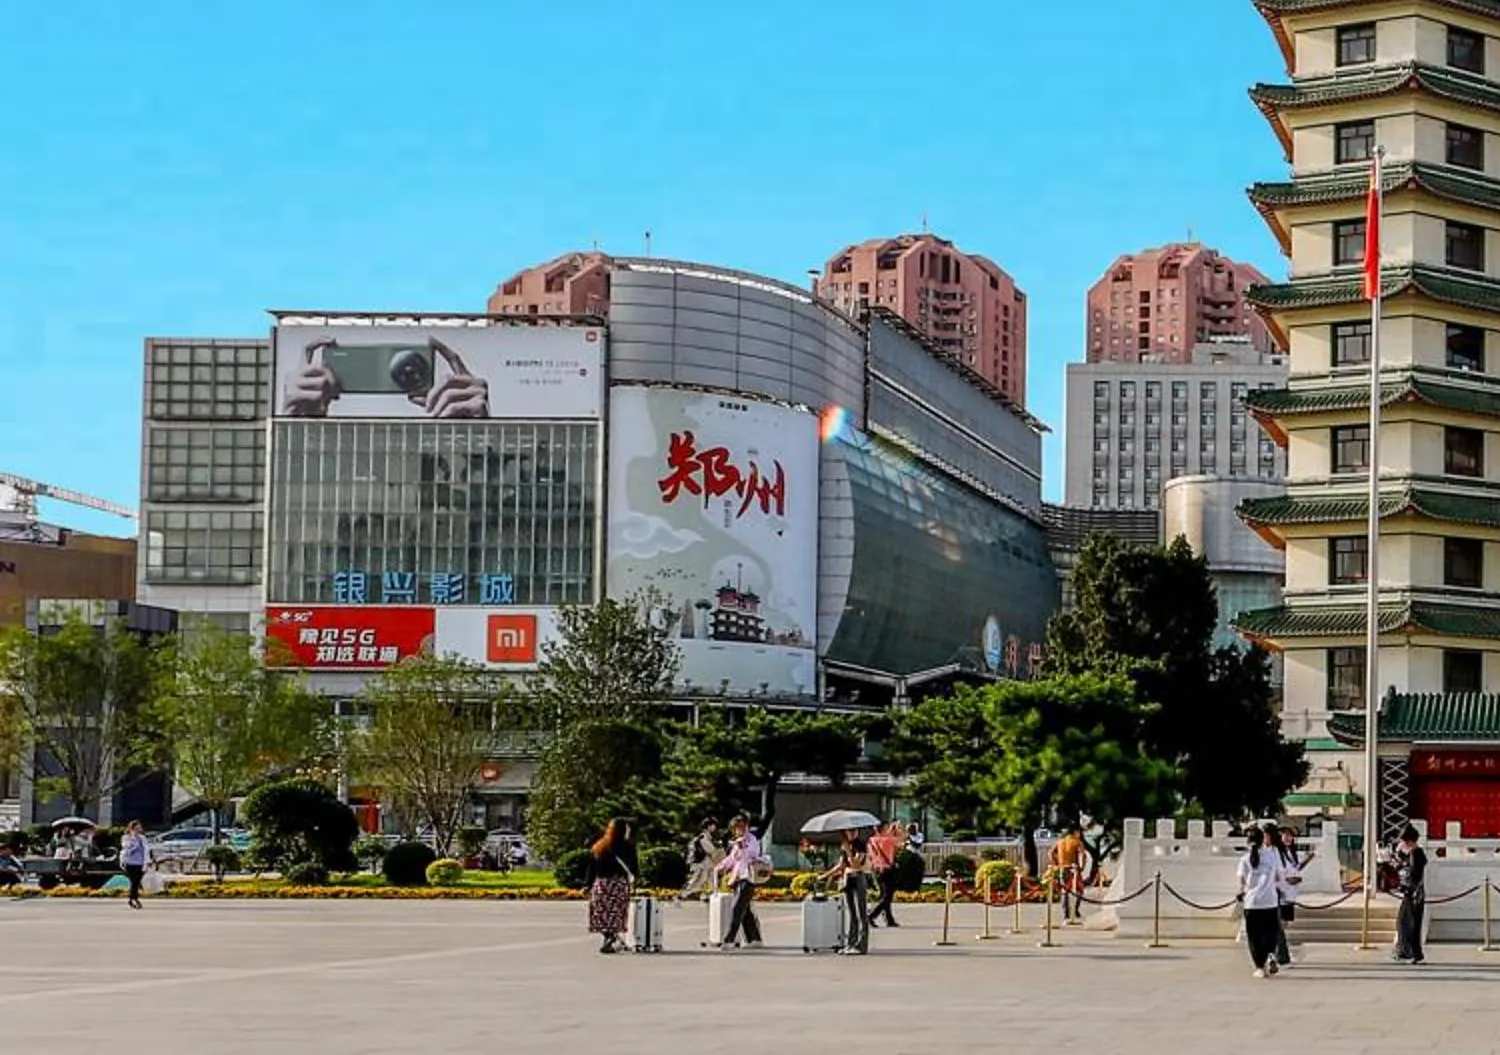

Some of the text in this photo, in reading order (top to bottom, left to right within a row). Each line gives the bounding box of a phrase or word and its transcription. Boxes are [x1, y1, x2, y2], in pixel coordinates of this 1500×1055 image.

[658, 430, 785, 519] 郑州
[334, 572, 514, 604] 银兴影城
[316, 647, 398, 663] 郑选联通
